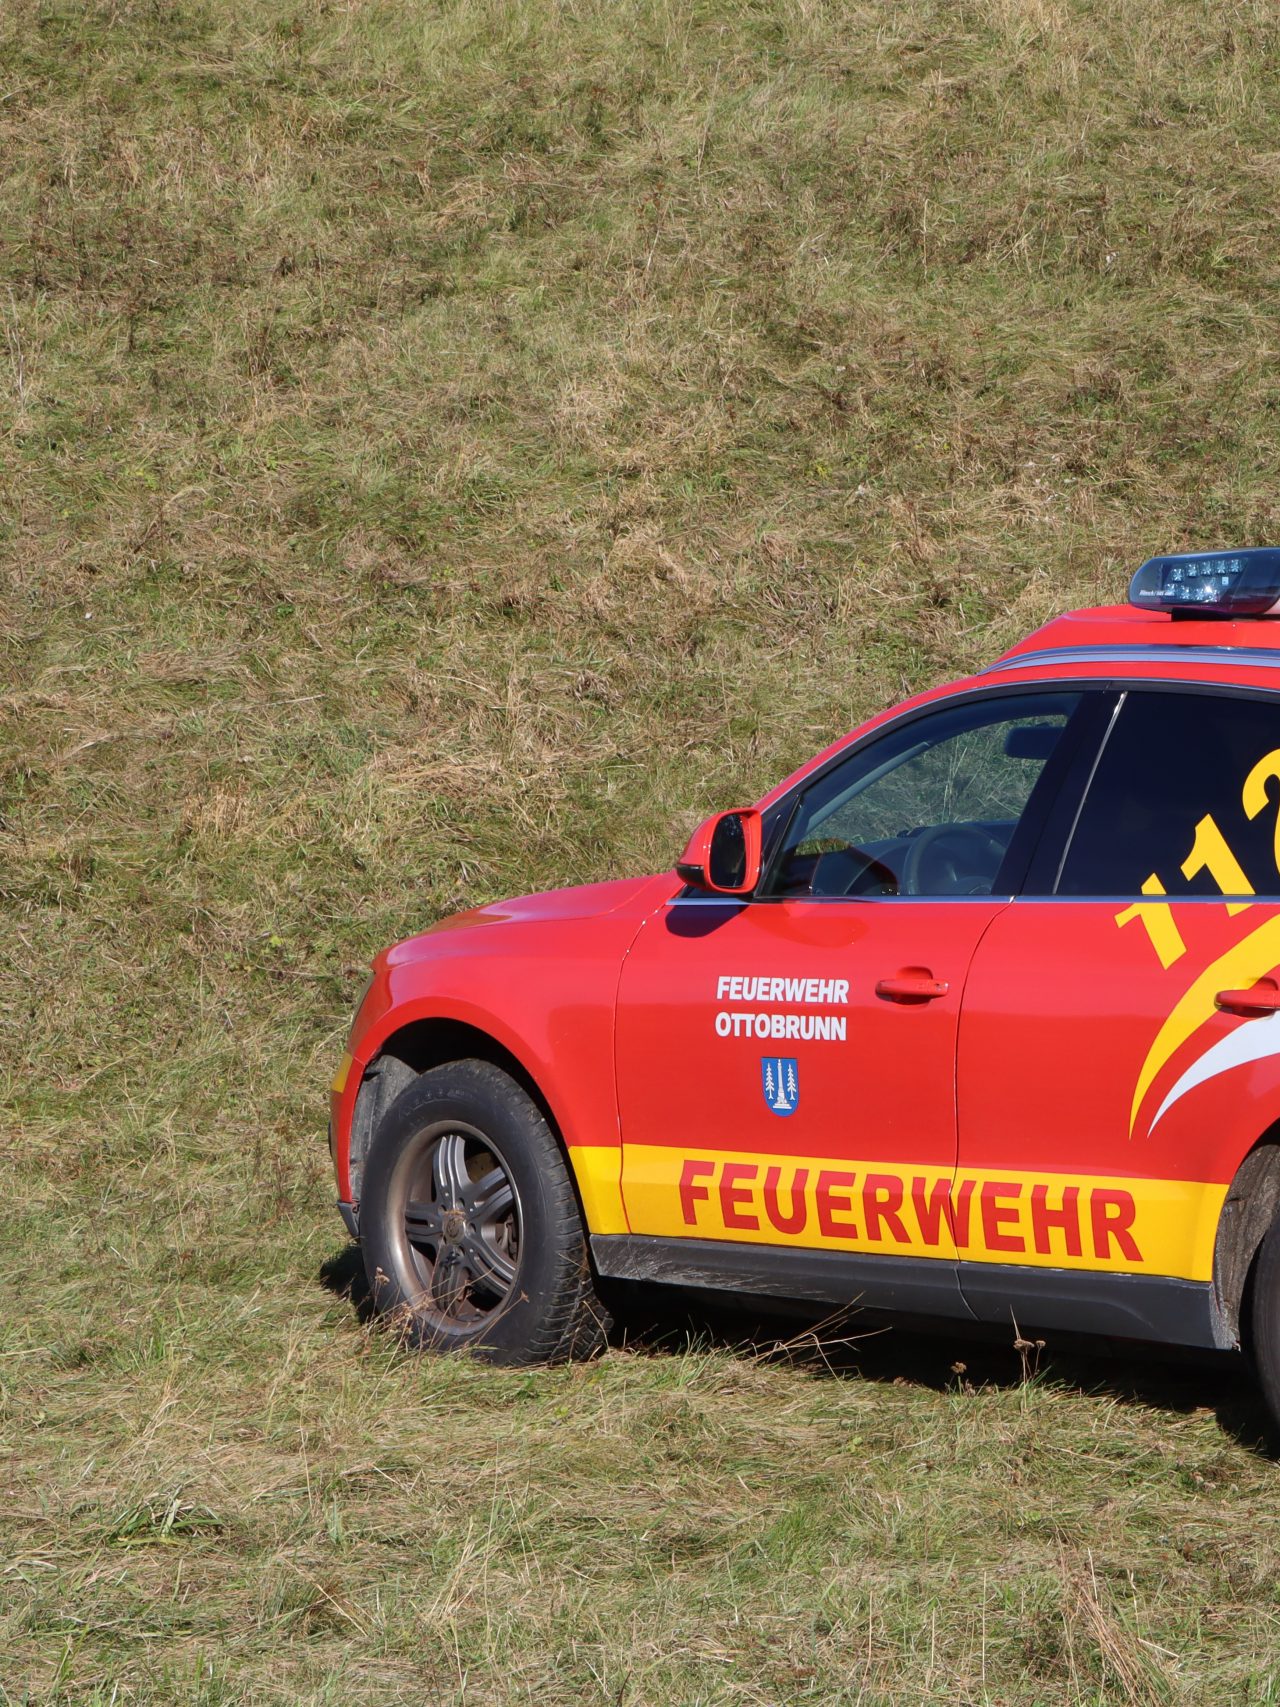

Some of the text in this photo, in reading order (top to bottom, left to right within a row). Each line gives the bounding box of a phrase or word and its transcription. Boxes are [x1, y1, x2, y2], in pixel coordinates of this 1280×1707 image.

[716, 975, 850, 1004] FEUERWEHR
[714, 1011, 847, 1041] OTTOBRUNN
[679, 1159, 1145, 1262] FEUERWEHR
